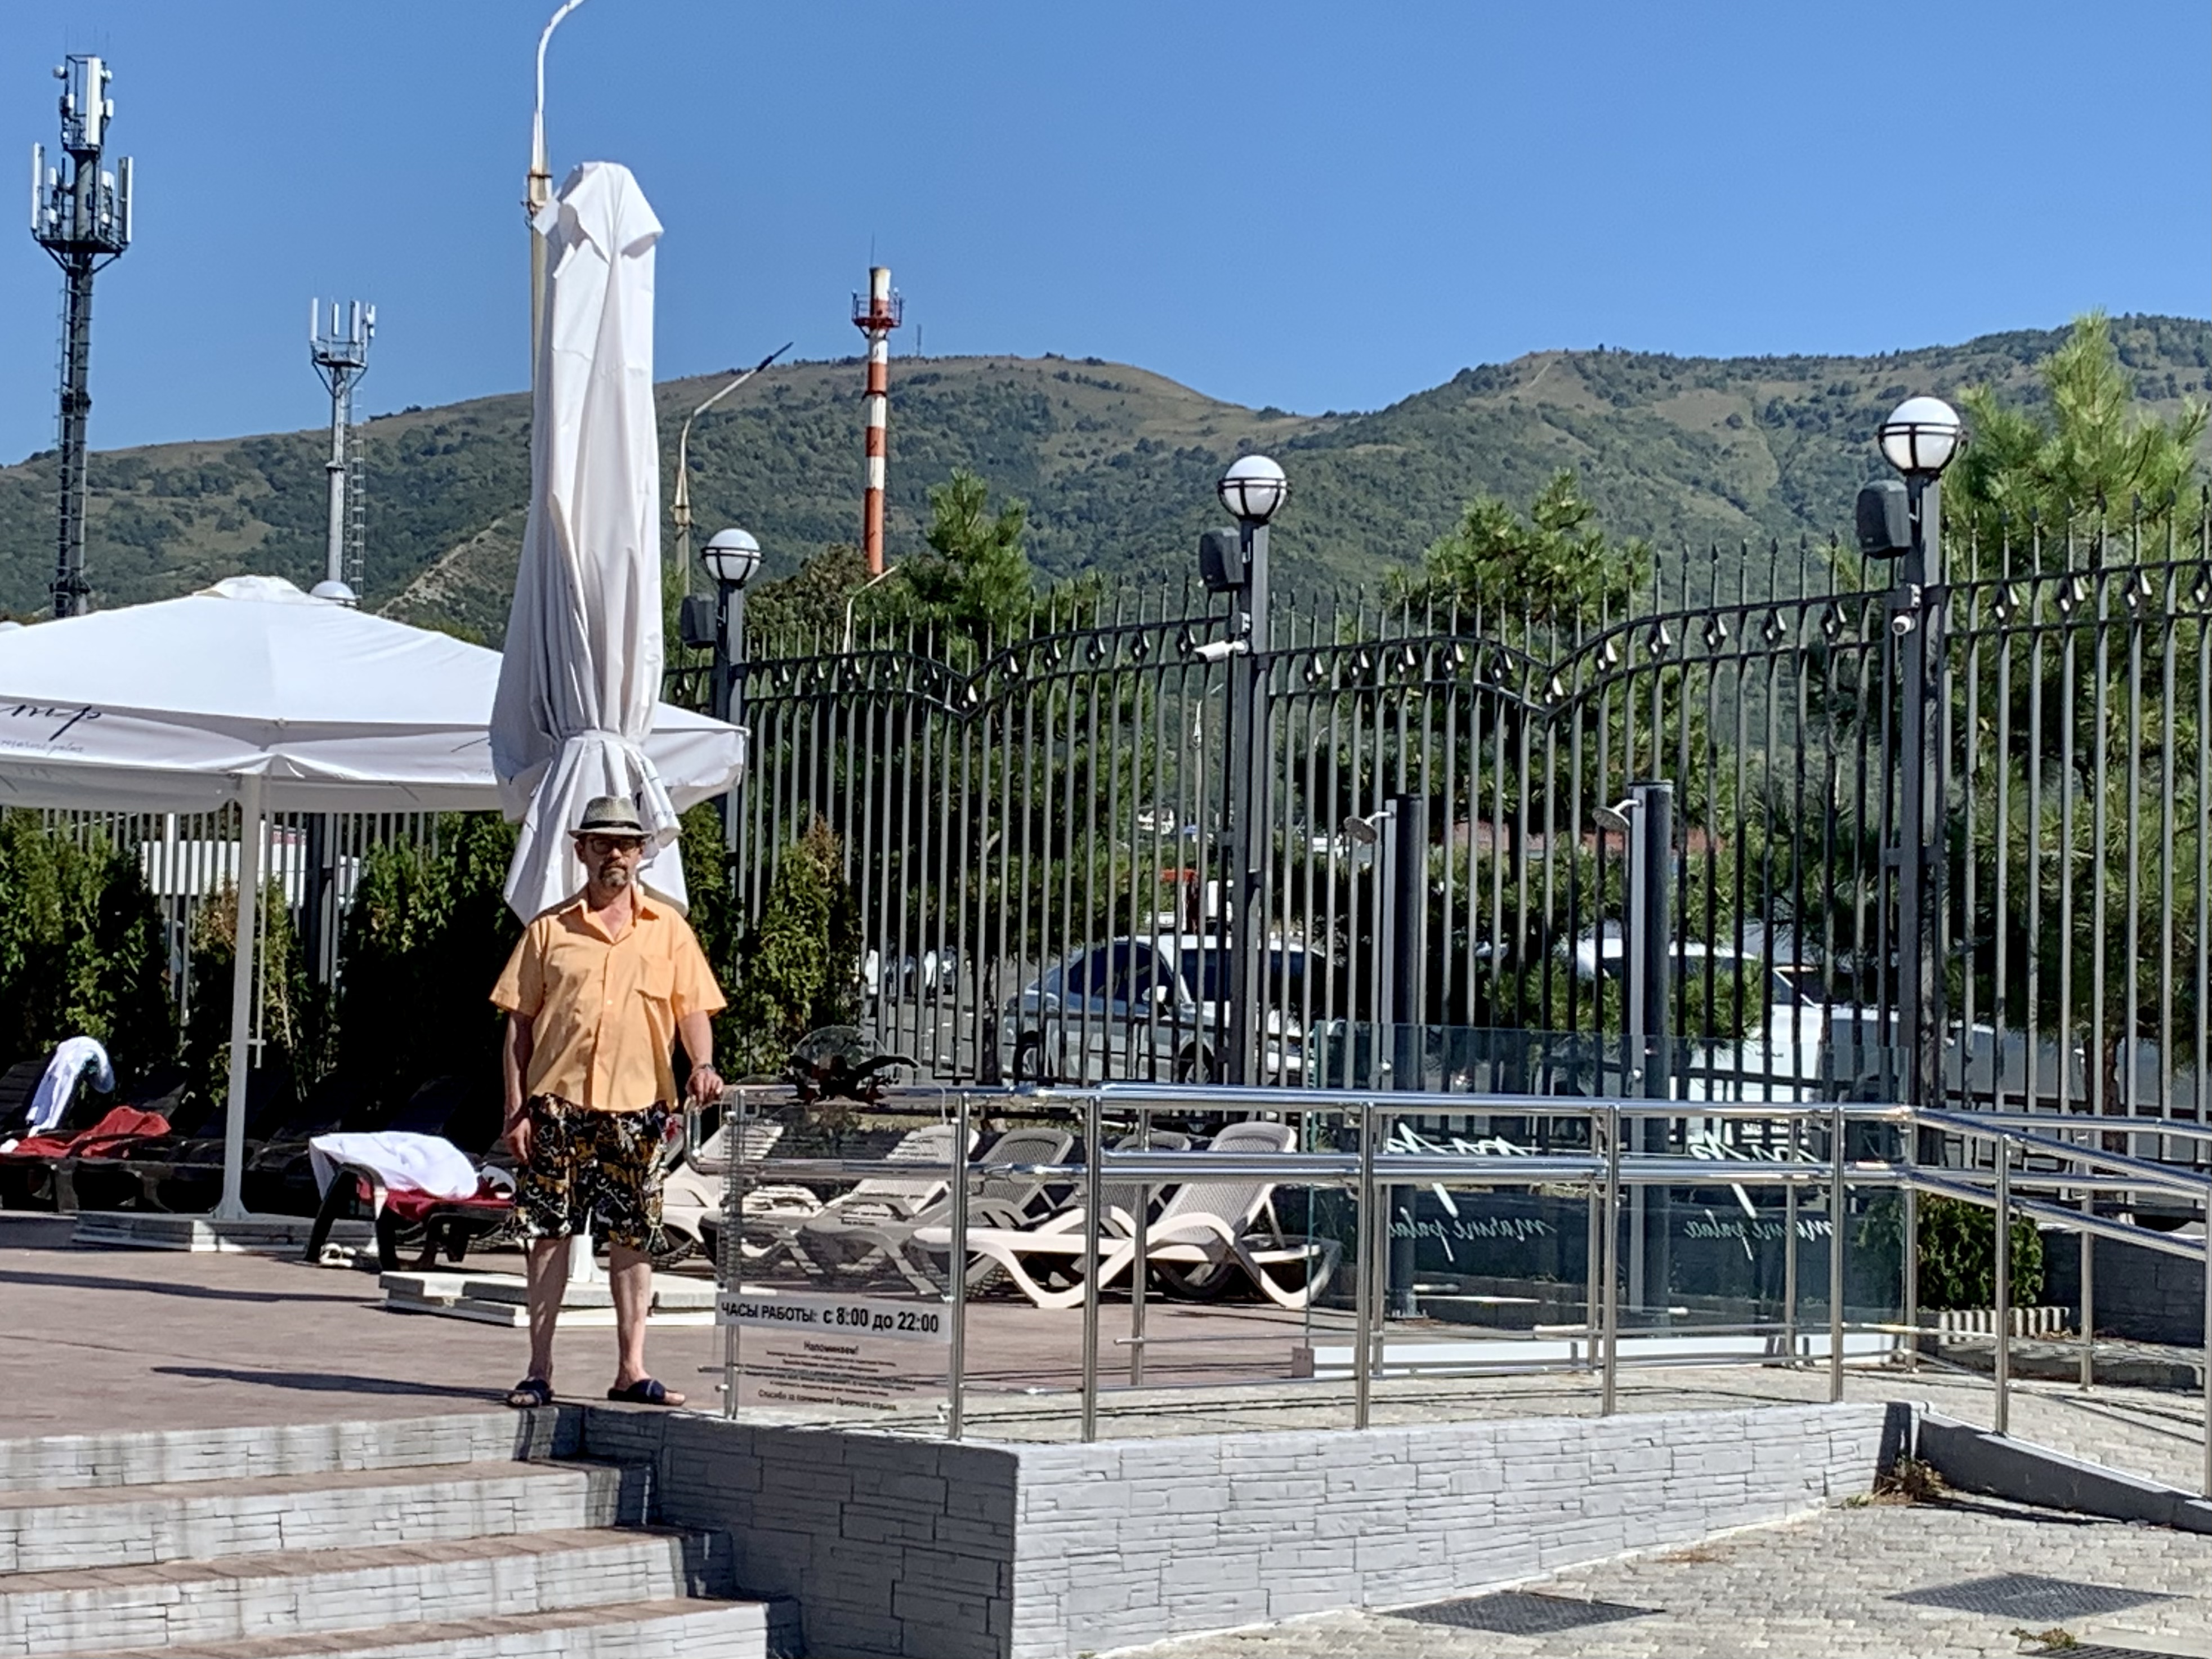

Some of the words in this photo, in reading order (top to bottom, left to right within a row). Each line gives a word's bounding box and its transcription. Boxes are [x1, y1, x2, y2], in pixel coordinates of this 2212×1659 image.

[721, 1302, 758, 1318] ЧАСЫ
[761, 1305, 817, 1323] РАБОТЫ:
[835, 1307, 869, 1327] 8:00
[872, 1314, 893, 1331] до
[897, 1312, 939, 1333] 22:00
